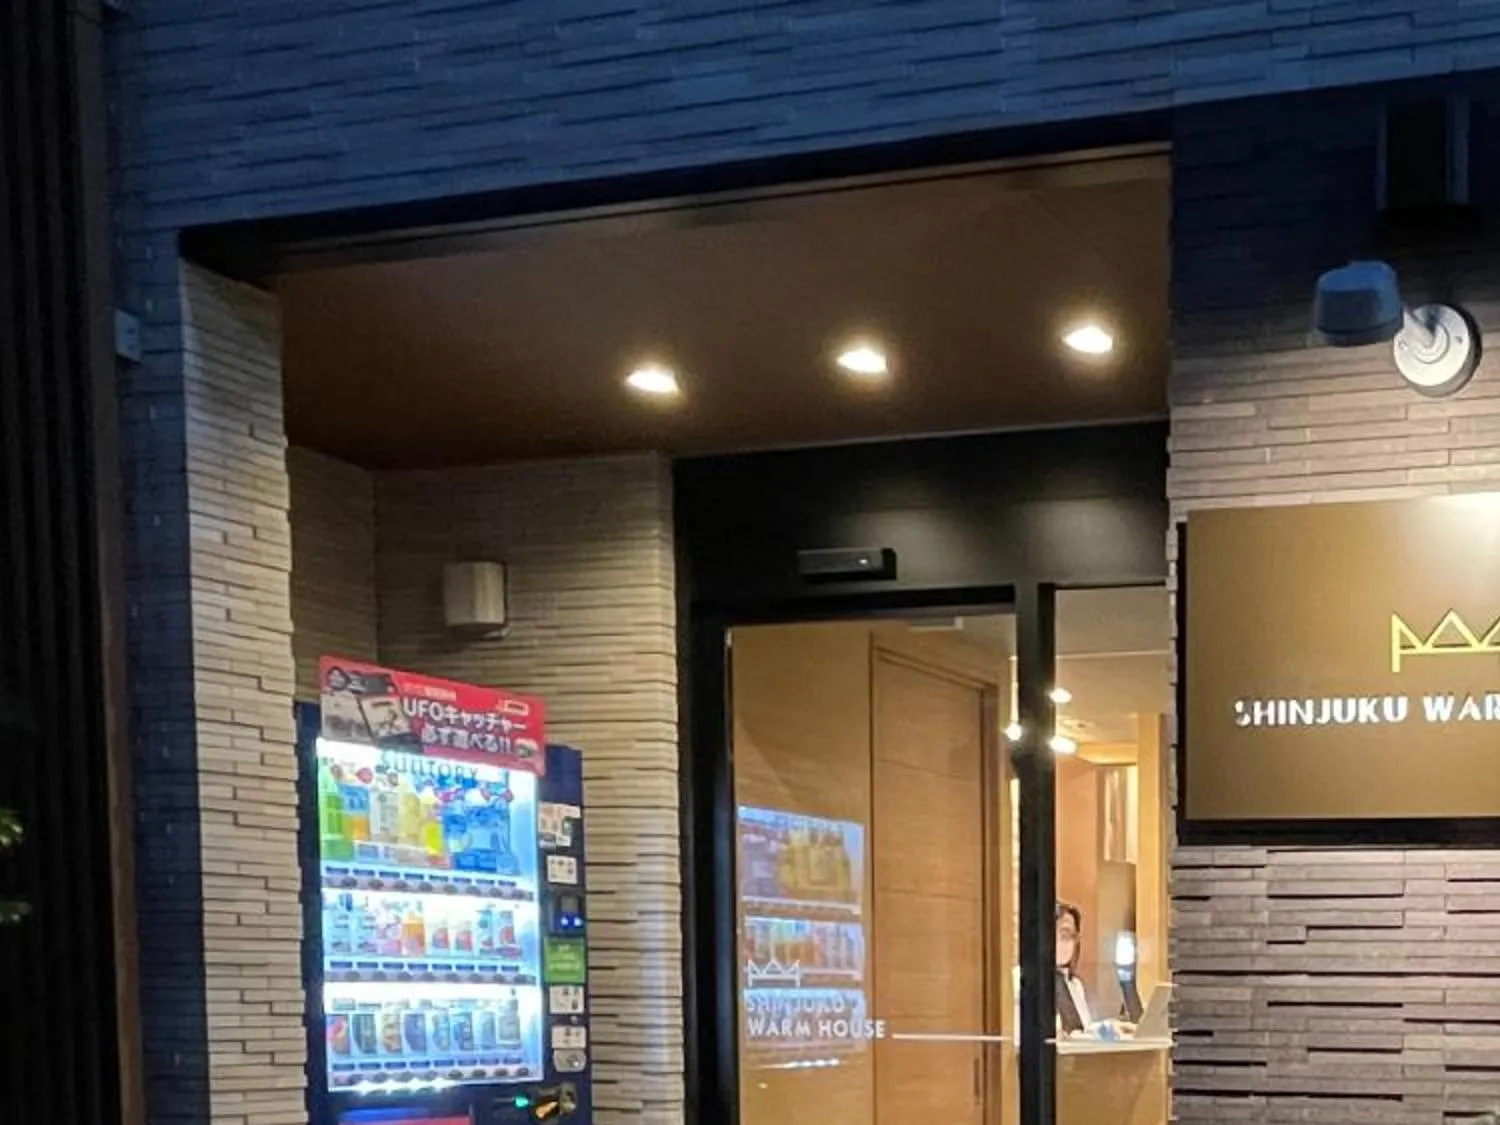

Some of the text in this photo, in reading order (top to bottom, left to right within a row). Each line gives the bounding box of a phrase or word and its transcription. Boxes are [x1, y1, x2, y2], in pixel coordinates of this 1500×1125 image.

[1234, 695, 1408, 727] SHINJUKU
[748, 1015, 887, 1039] WARM HOUSE
